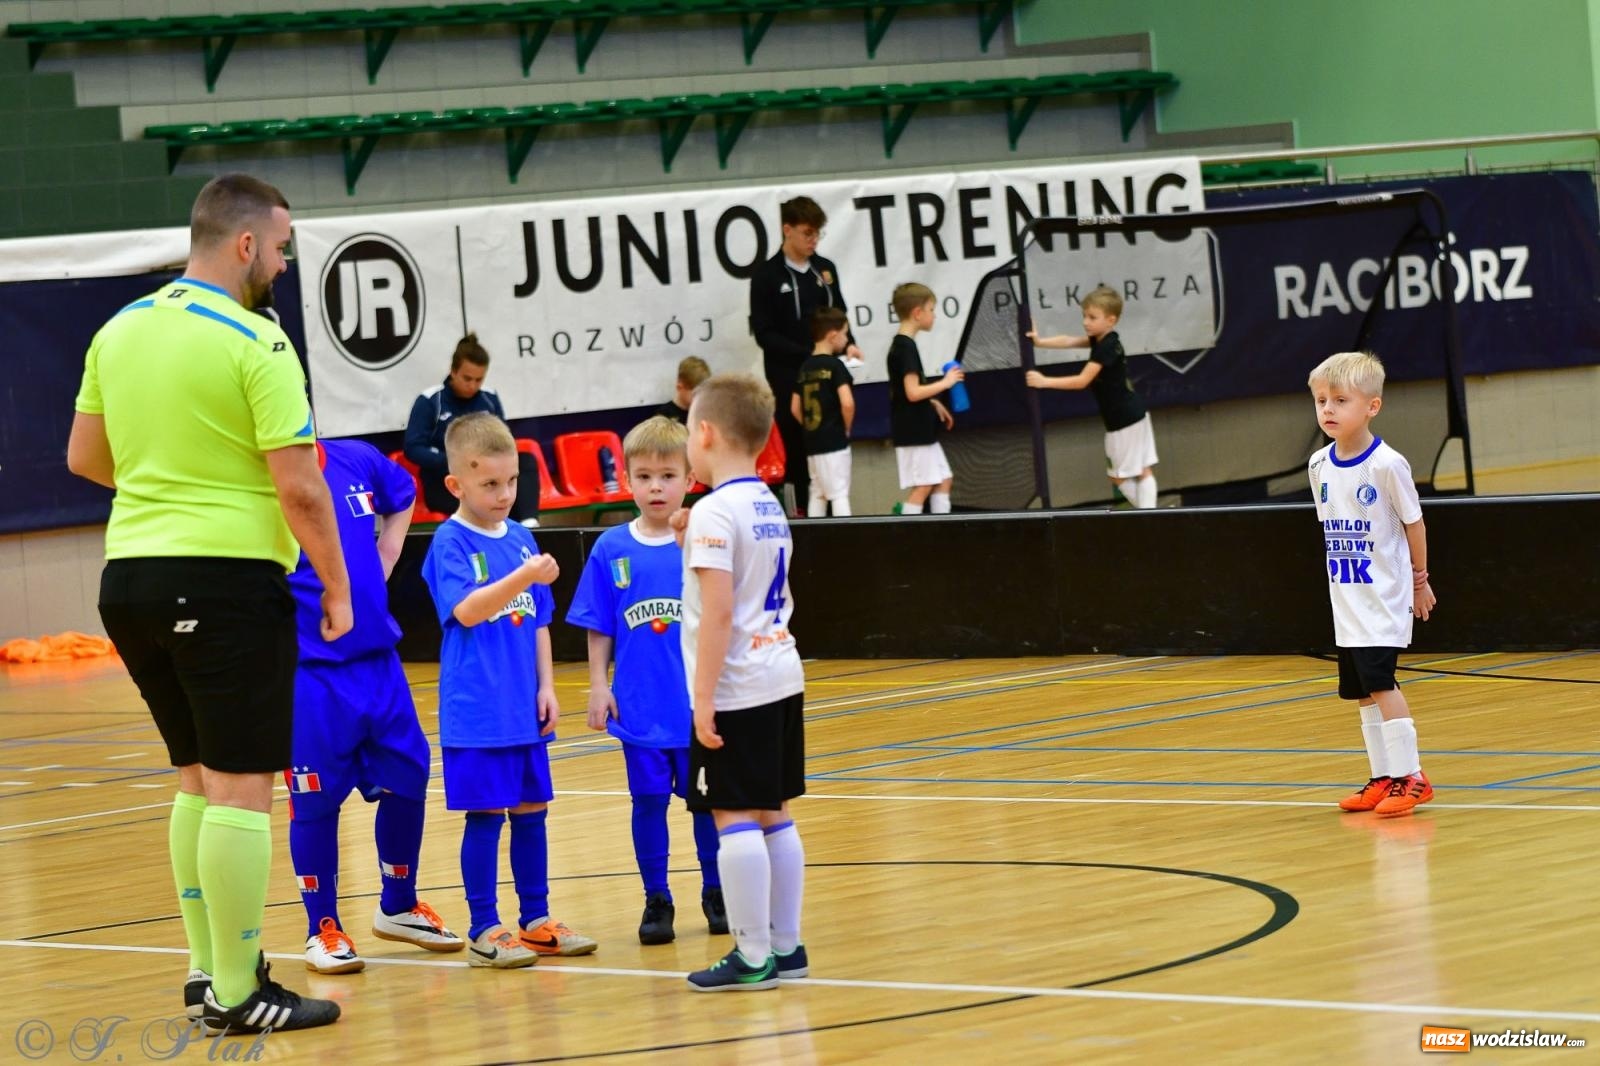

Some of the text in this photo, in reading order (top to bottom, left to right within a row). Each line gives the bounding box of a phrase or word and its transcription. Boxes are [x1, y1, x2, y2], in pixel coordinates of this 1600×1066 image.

[514, 173, 1191, 298] JUNIO TRENING
[517, 316, 715, 358] ROZWÓJ
[803, 382, 823, 431] 5
[1324, 519, 1371, 532] AWILON
[1325, 539, 1374, 552] EBLOWY
[763, 547, 787, 624] 4
[627, 601, 683, 623] TYMBAR
[696, 766, 708, 796] 4
